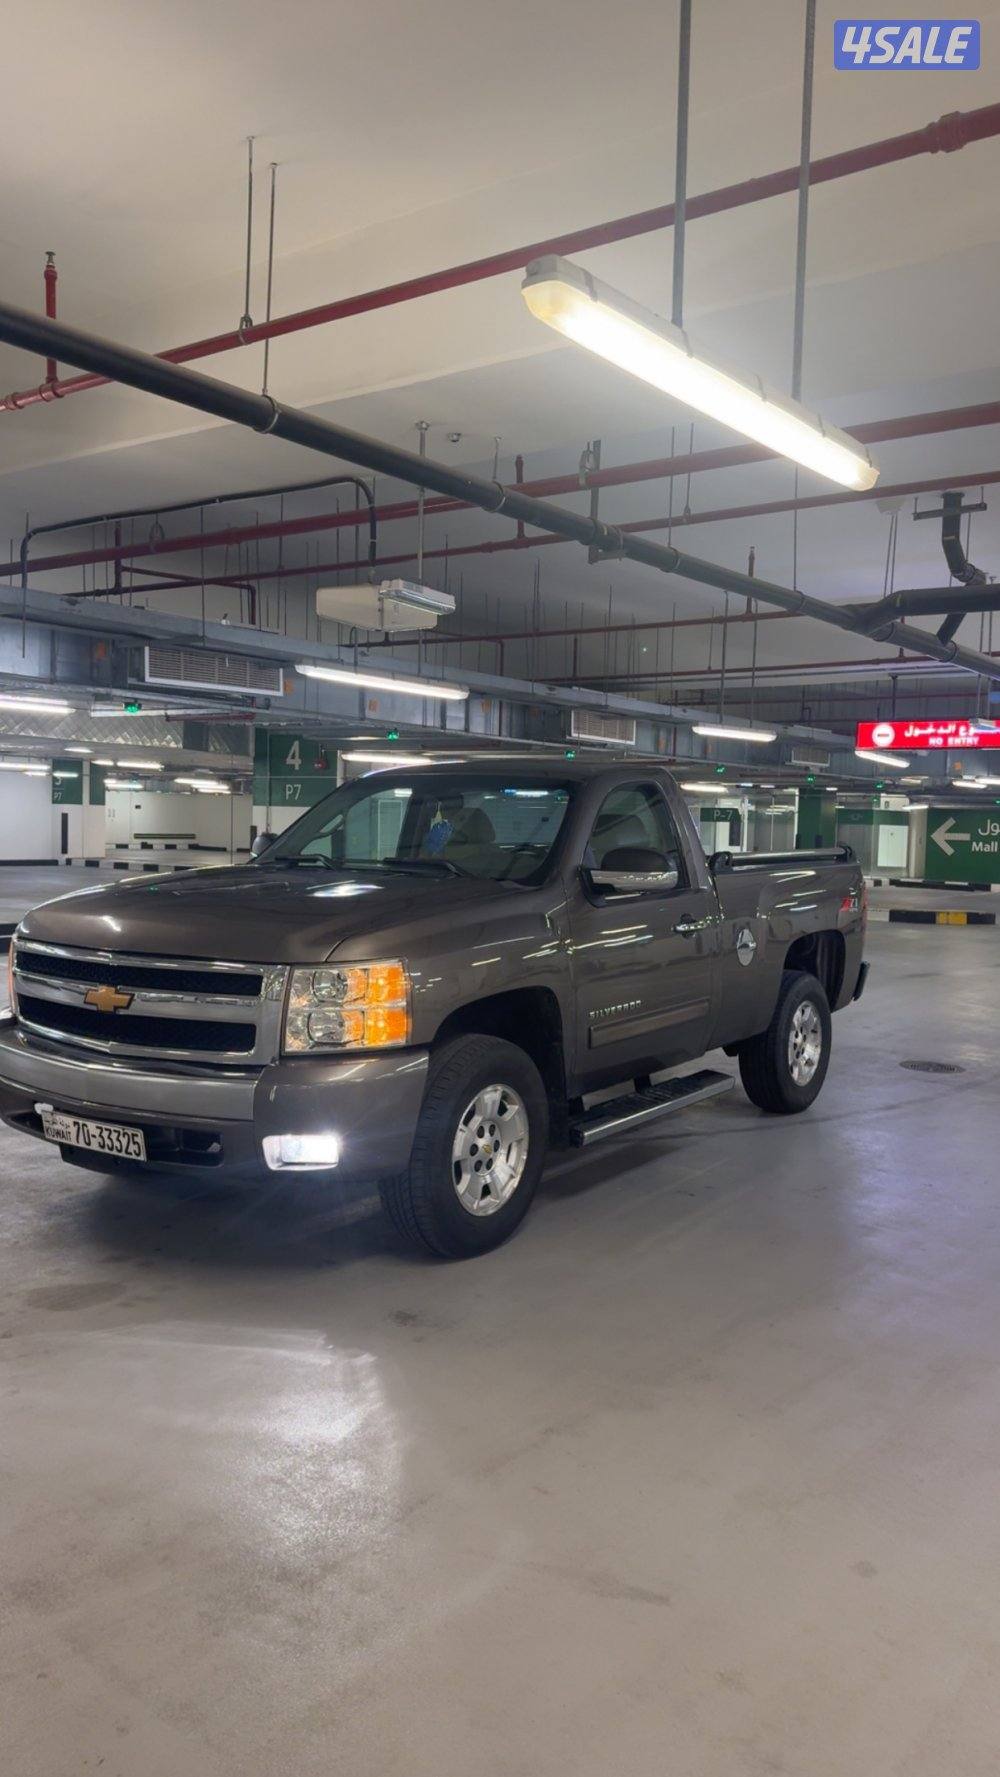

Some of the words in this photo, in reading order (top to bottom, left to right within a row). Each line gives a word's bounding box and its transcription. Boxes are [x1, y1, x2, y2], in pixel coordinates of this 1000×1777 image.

[928, 736, 943, 745] NO
[947, 736, 979, 746] ENTRY
[285, 740, 301, 770] 4
[285, 784, 301, 800] P7
[971, 841, 998, 852] Mall
[46, 1126, 72, 1141] KUWAIT
[73, 1121, 140, 1157] 70-33325
